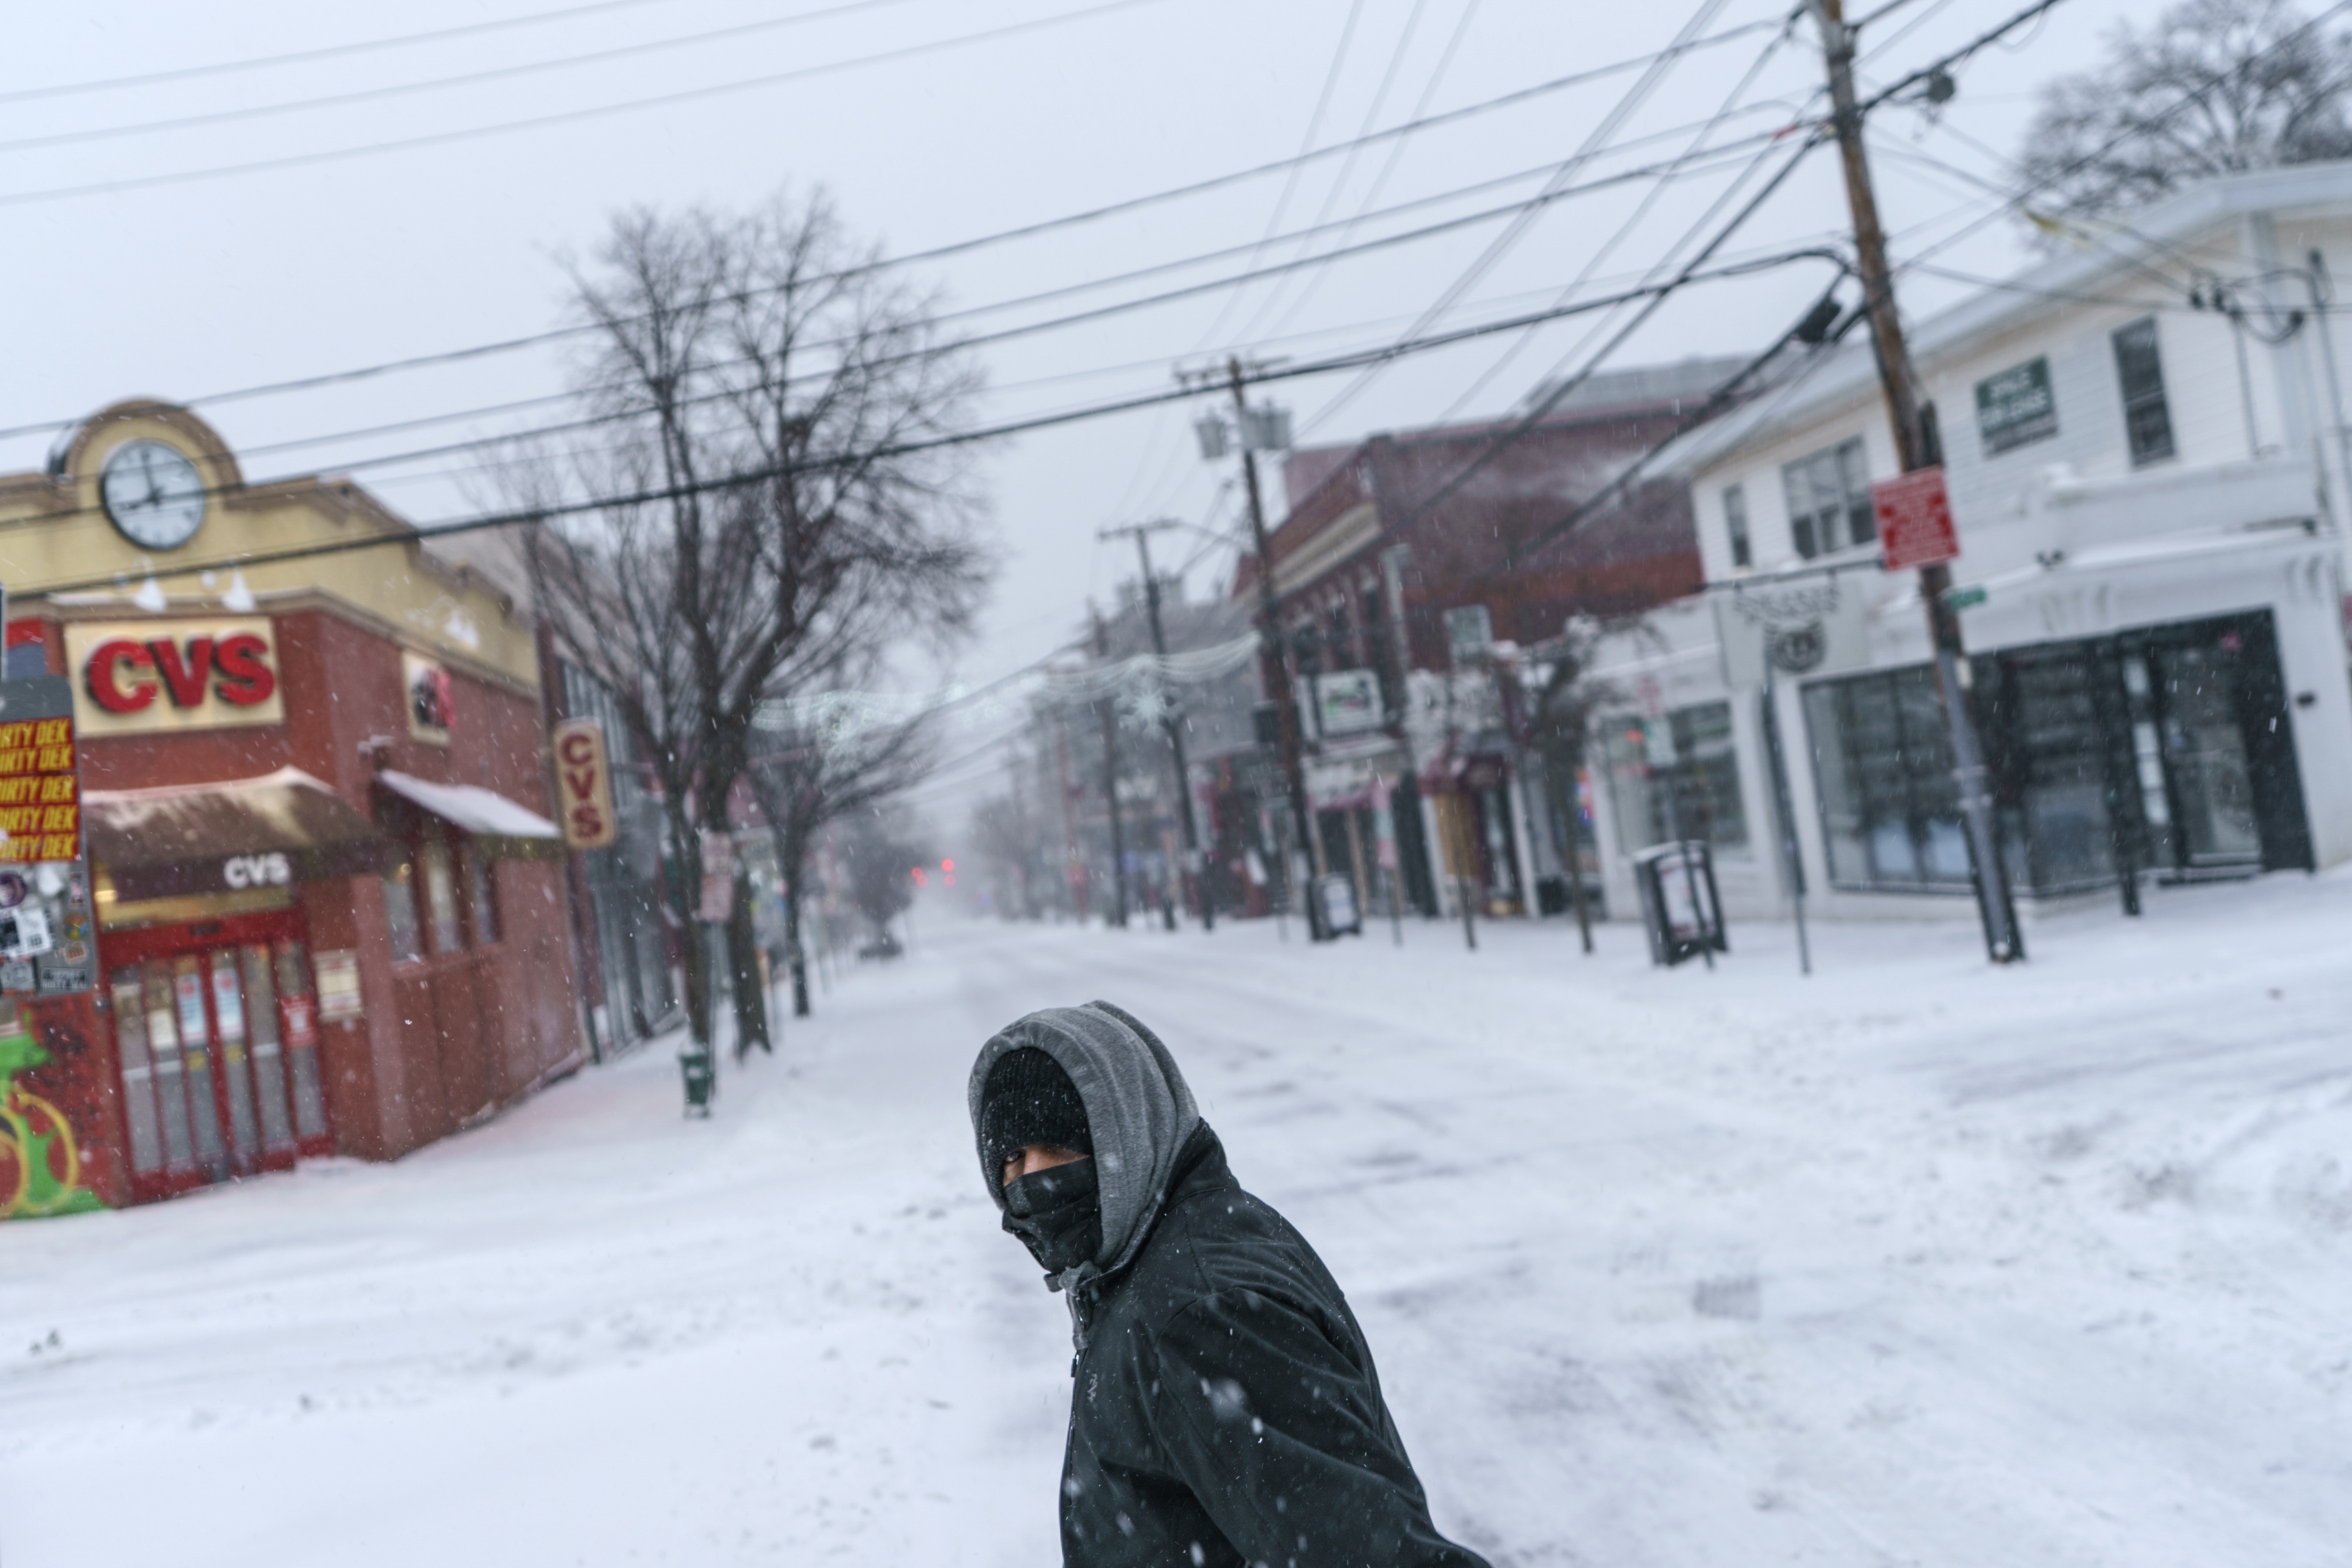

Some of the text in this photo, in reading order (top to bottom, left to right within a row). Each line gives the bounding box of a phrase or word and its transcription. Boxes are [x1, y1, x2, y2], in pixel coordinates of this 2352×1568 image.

[86, 632, 275, 715] CVS
[35, 717, 71, 746] DEK
[38, 744, 74, 770] DEK
[0, 775, 77, 804] IRTY DEK
[560, 732, 603, 839] CVS
[42, 804, 78, 832] DEK
[40, 832, 77, 860] DEK
[223, 850, 290, 888] CVS
